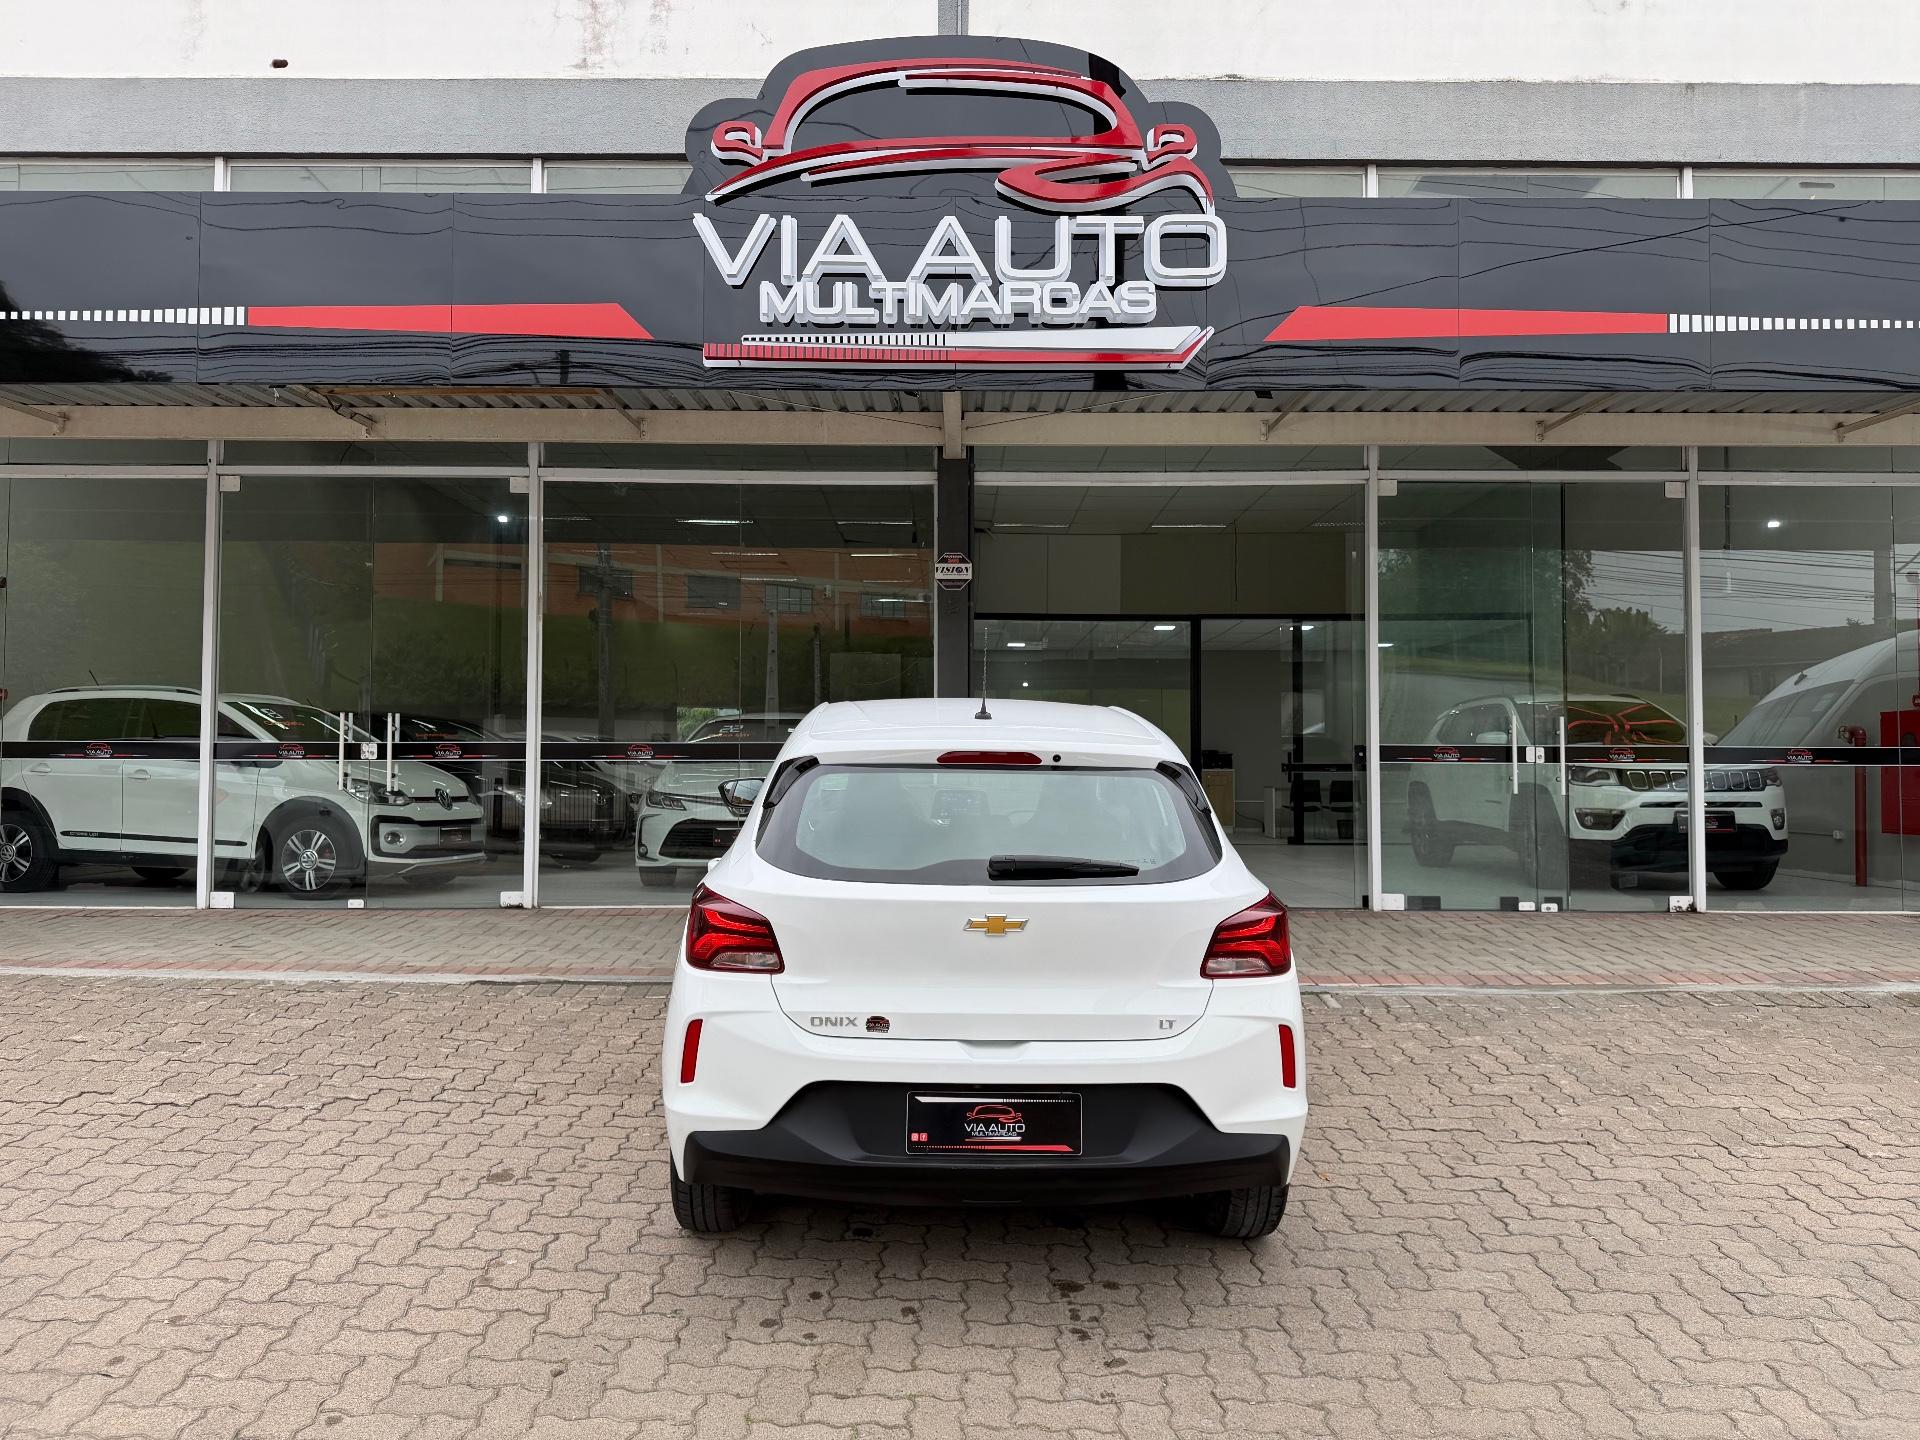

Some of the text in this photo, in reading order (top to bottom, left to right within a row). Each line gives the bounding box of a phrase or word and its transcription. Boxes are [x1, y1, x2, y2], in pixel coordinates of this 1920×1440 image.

[693, 213, 1228, 287] VIA AUTO
[759, 280, 1157, 325] MULTIMARCAS
[935, 566, 971, 574] VISION
[810, 1016, 859, 1027] ONIX
[1159, 1019, 1177, 1030] LT
[964, 1123, 1026, 1133] VIA AUTO
